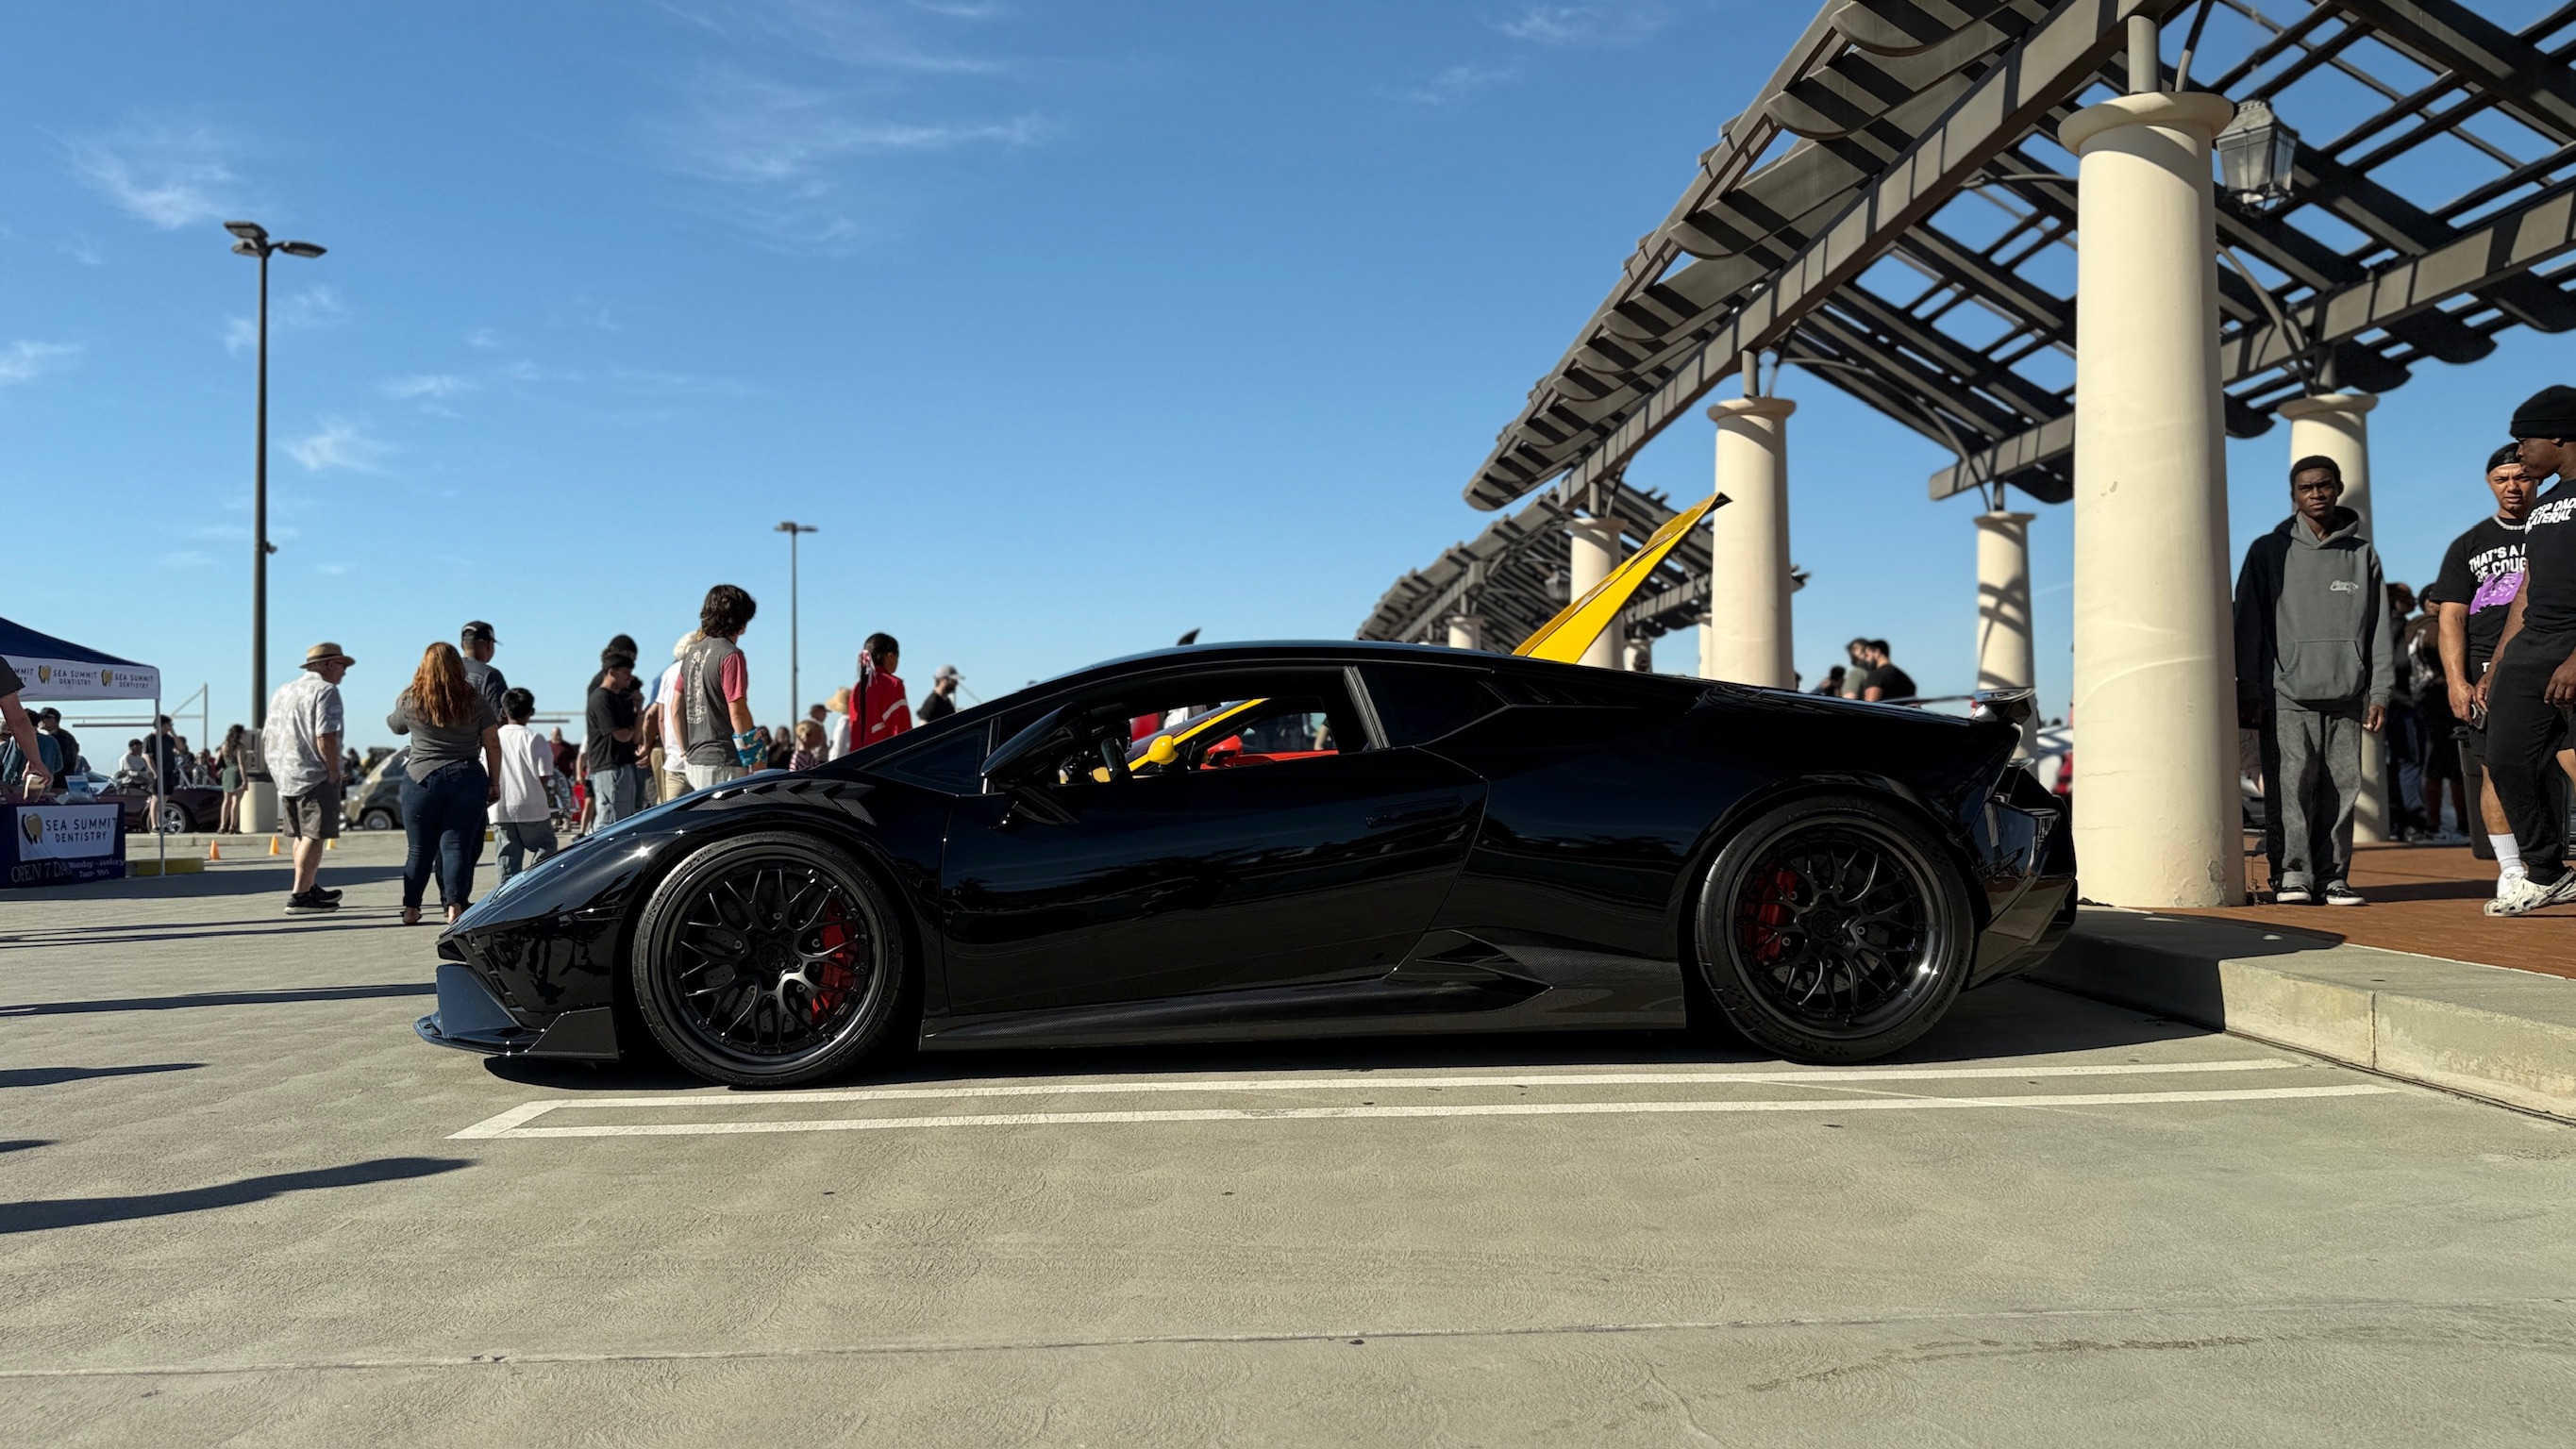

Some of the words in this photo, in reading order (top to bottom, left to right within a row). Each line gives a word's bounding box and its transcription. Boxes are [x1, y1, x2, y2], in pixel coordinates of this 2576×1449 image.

[2524, 508, 2572, 535] MATERIAL
[2468, 546, 2507, 574] THAT'S
[2509, 544, 2519, 557] A
[53, 669, 67, 677] SEA
[70, 670, 97, 680] SUMMIT
[114, 673, 127, 681] SEA
[130, 674, 154, 682] SUMMIT
[59, 677, 92, 686] DENTISTRY
[119, 681, 149, 690] DENTISTRY
[45, 819, 67, 831] SEA
[74, 817, 116, 830] SUMMIT
[55, 831, 107, 843] DENTISTRY
